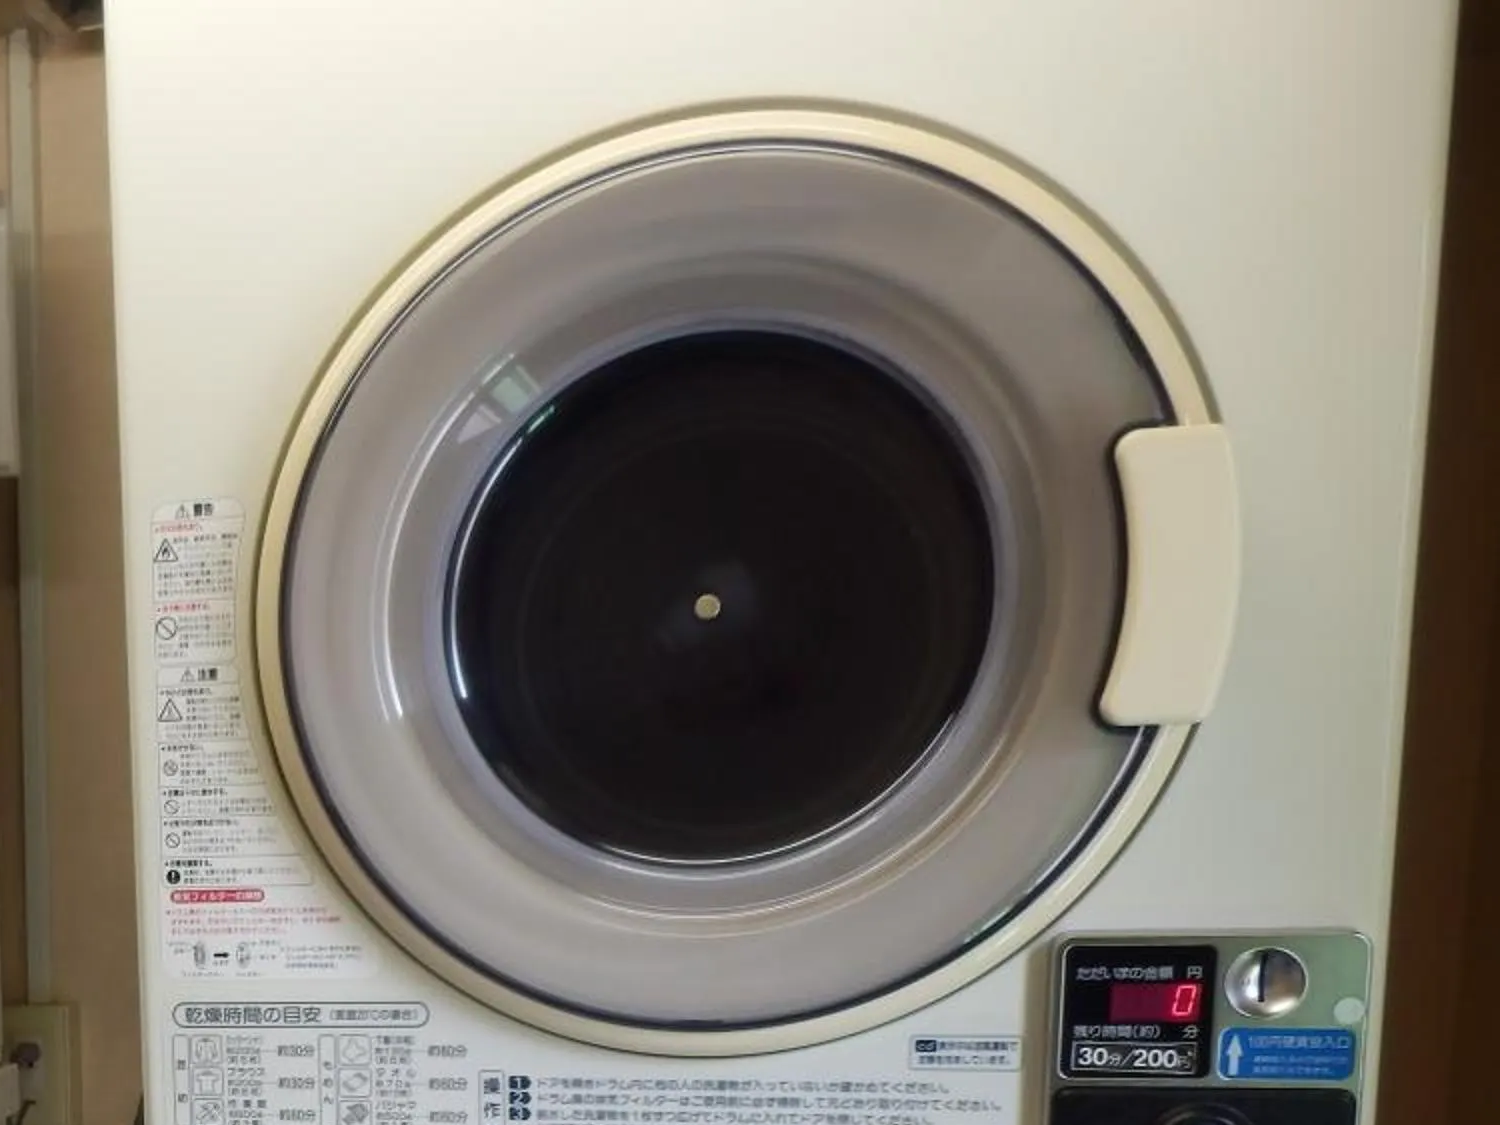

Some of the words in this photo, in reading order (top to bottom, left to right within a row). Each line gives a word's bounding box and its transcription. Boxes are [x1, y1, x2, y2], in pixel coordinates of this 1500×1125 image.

[1172, 984, 1197, 1016] 0
[184, 1006, 322, 1025] 乾燥時間の目安
